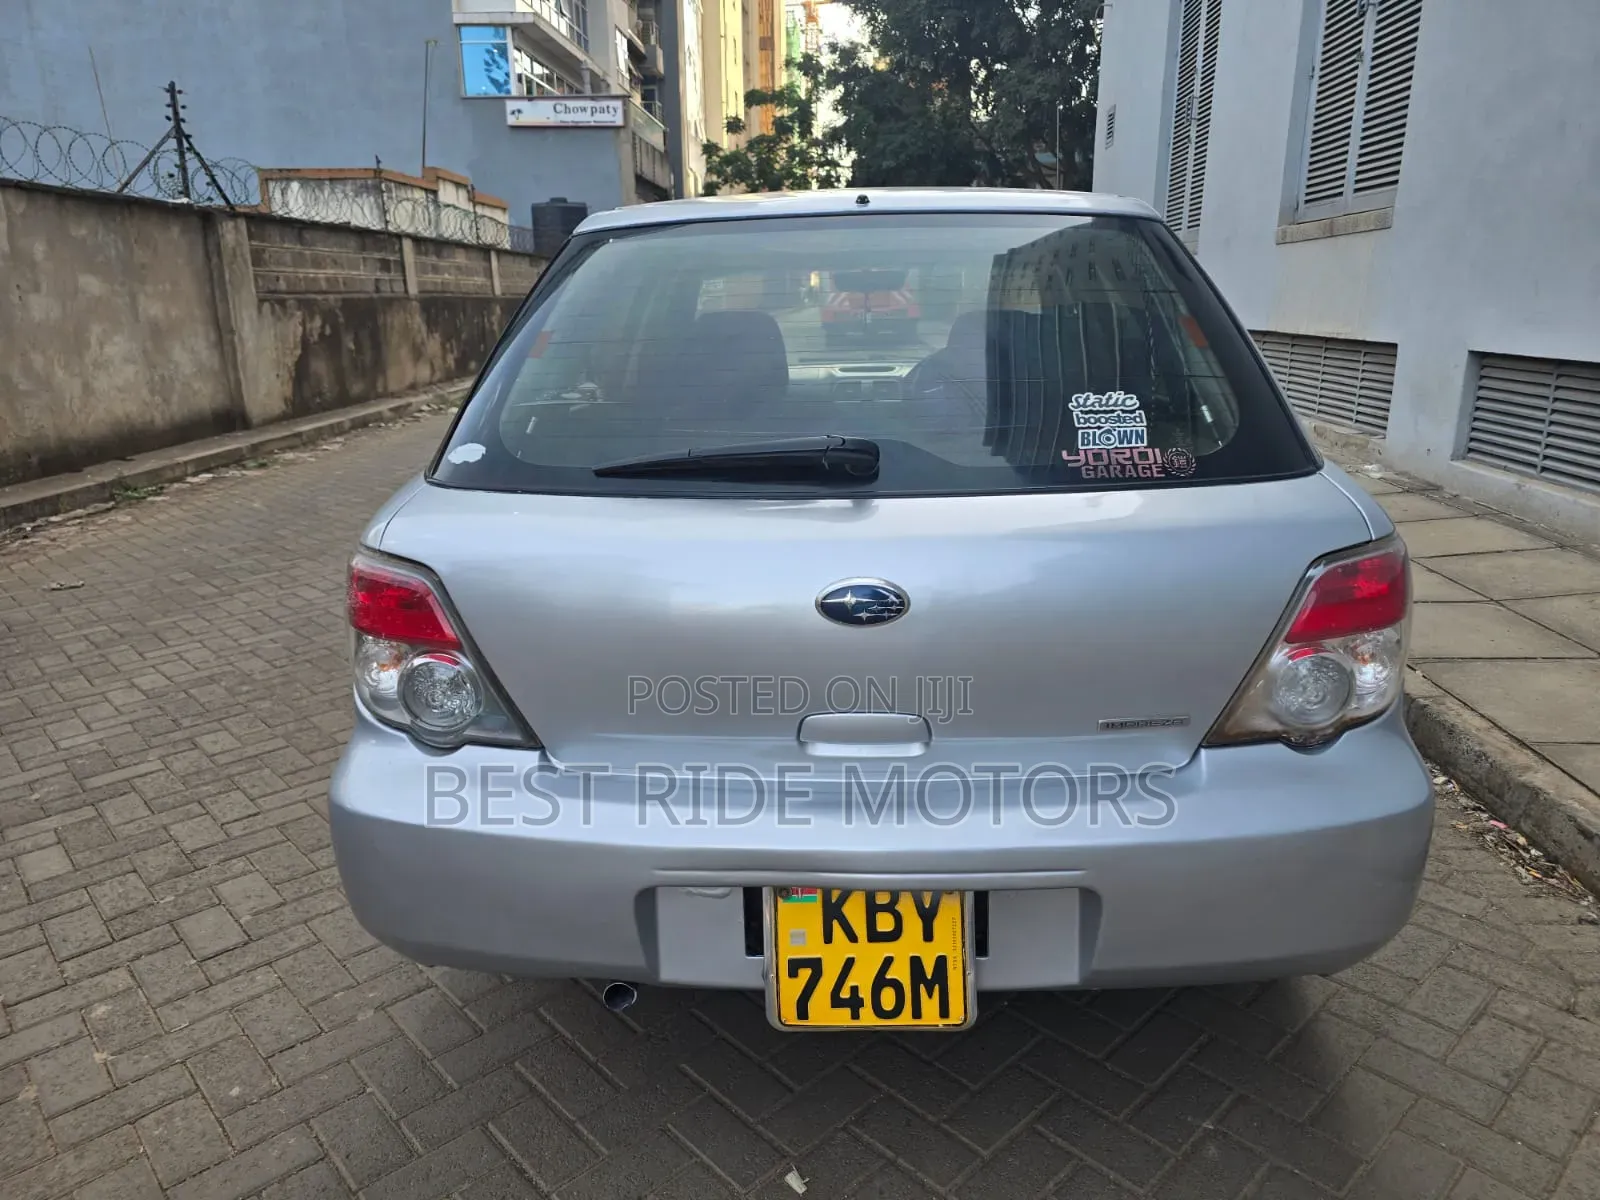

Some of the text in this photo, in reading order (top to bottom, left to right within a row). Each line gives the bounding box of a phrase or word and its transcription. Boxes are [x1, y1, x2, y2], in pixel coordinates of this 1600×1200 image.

[553, 102, 619, 117] Chowpaty
[1069, 391, 1139, 410] static
[1074, 411, 1146, 427] boosted
[1081, 464, 1165, 479] GARAGE
[822, 889, 943, 944] KBY
[787, 955, 950, 1021] 746M
